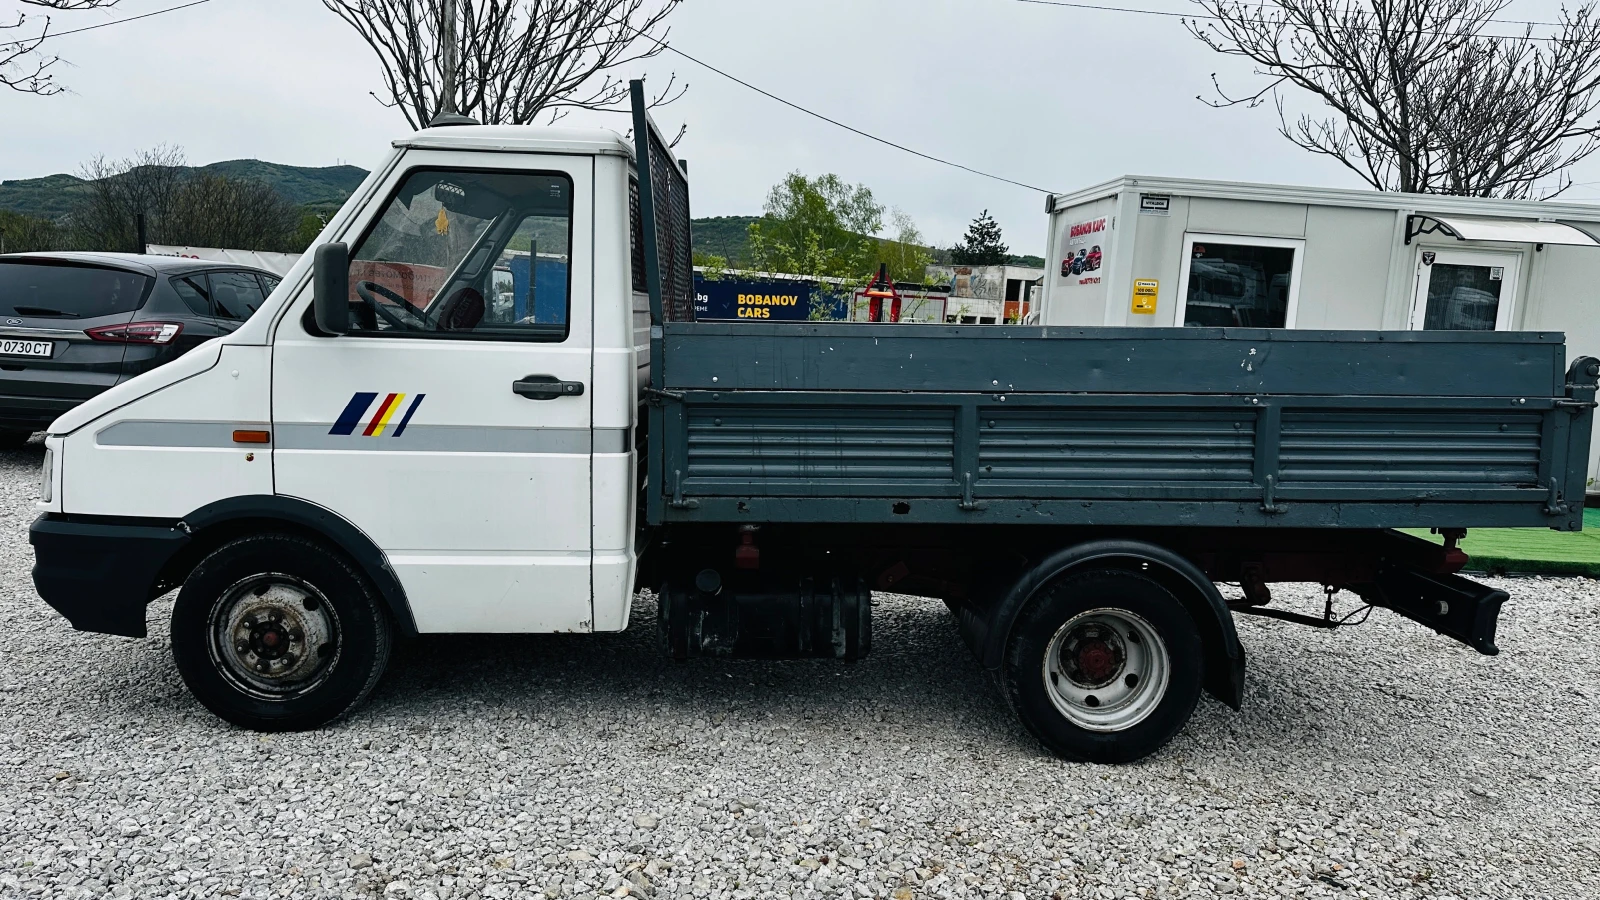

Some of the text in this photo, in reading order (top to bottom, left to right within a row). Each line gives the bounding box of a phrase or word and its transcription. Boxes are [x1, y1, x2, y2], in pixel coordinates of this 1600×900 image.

[1093, 219, 1106, 233] КАРС
[737, 294, 798, 306] BOBANOV
[737, 307, 770, 318] CARS
[4, 341, 32, 353] 0730
[33, 343, 50, 354] CT
